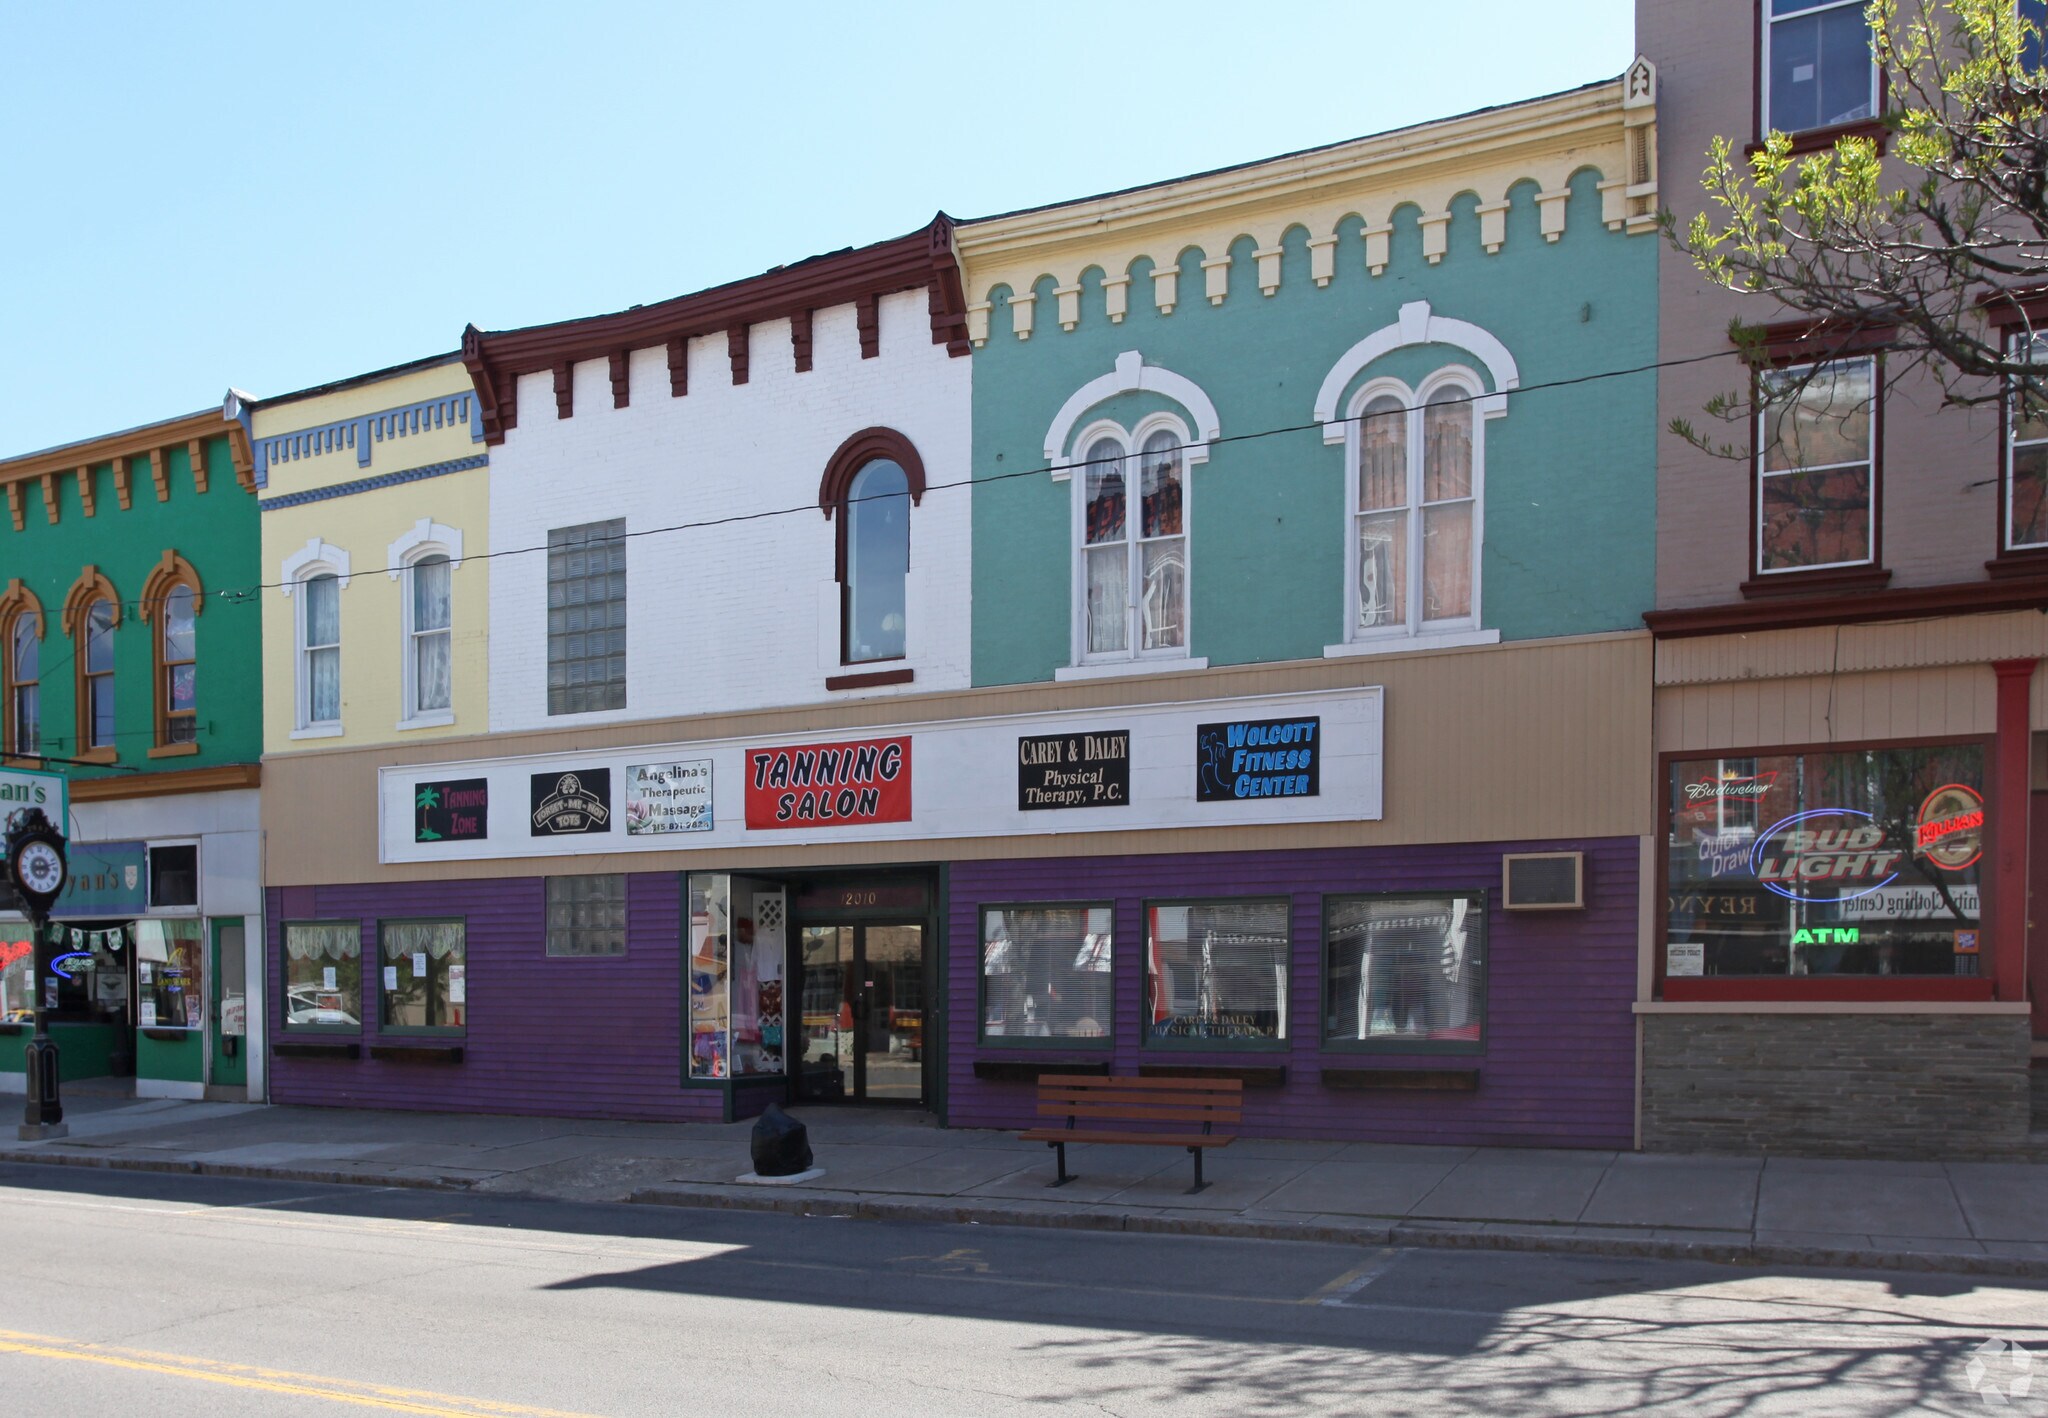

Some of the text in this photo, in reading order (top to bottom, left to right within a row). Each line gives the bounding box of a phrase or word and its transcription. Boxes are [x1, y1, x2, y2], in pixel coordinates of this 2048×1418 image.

[1227, 722, 1316, 748] WOLCOTT
[1020, 736, 1127, 765] CAREY & DALEY
[1232, 749, 1311, 772] FITNESS
[637, 763, 708, 784] Angelina's
[754, 743, 902, 790] TANNING
[1043, 767, 1104, 788] Physical
[640, 785, 706, 799] Therapeutic
[1025, 783, 1122, 805] Therapy, P.C.
[1234, 774, 1309, 797] CENTER
[1685, 782, 1774, 799] Budweiser
[442, 787, 486, 808] TANNING
[776, 788, 880, 821] SALON
[556, 814, 581, 828] TOTS
[649, 802, 705, 818] Massage
[451, 813, 478, 834] ZONE
[1698, 834, 1740, 860] Quick
[1783, 828, 1886, 853] BUD
[1711, 847, 1751, 877] Draw
[1758, 854, 1901, 882] LIGHT
[1792, 927, 1859, 944] ATM
[1221, 1015, 1257, 1025] DALEY
